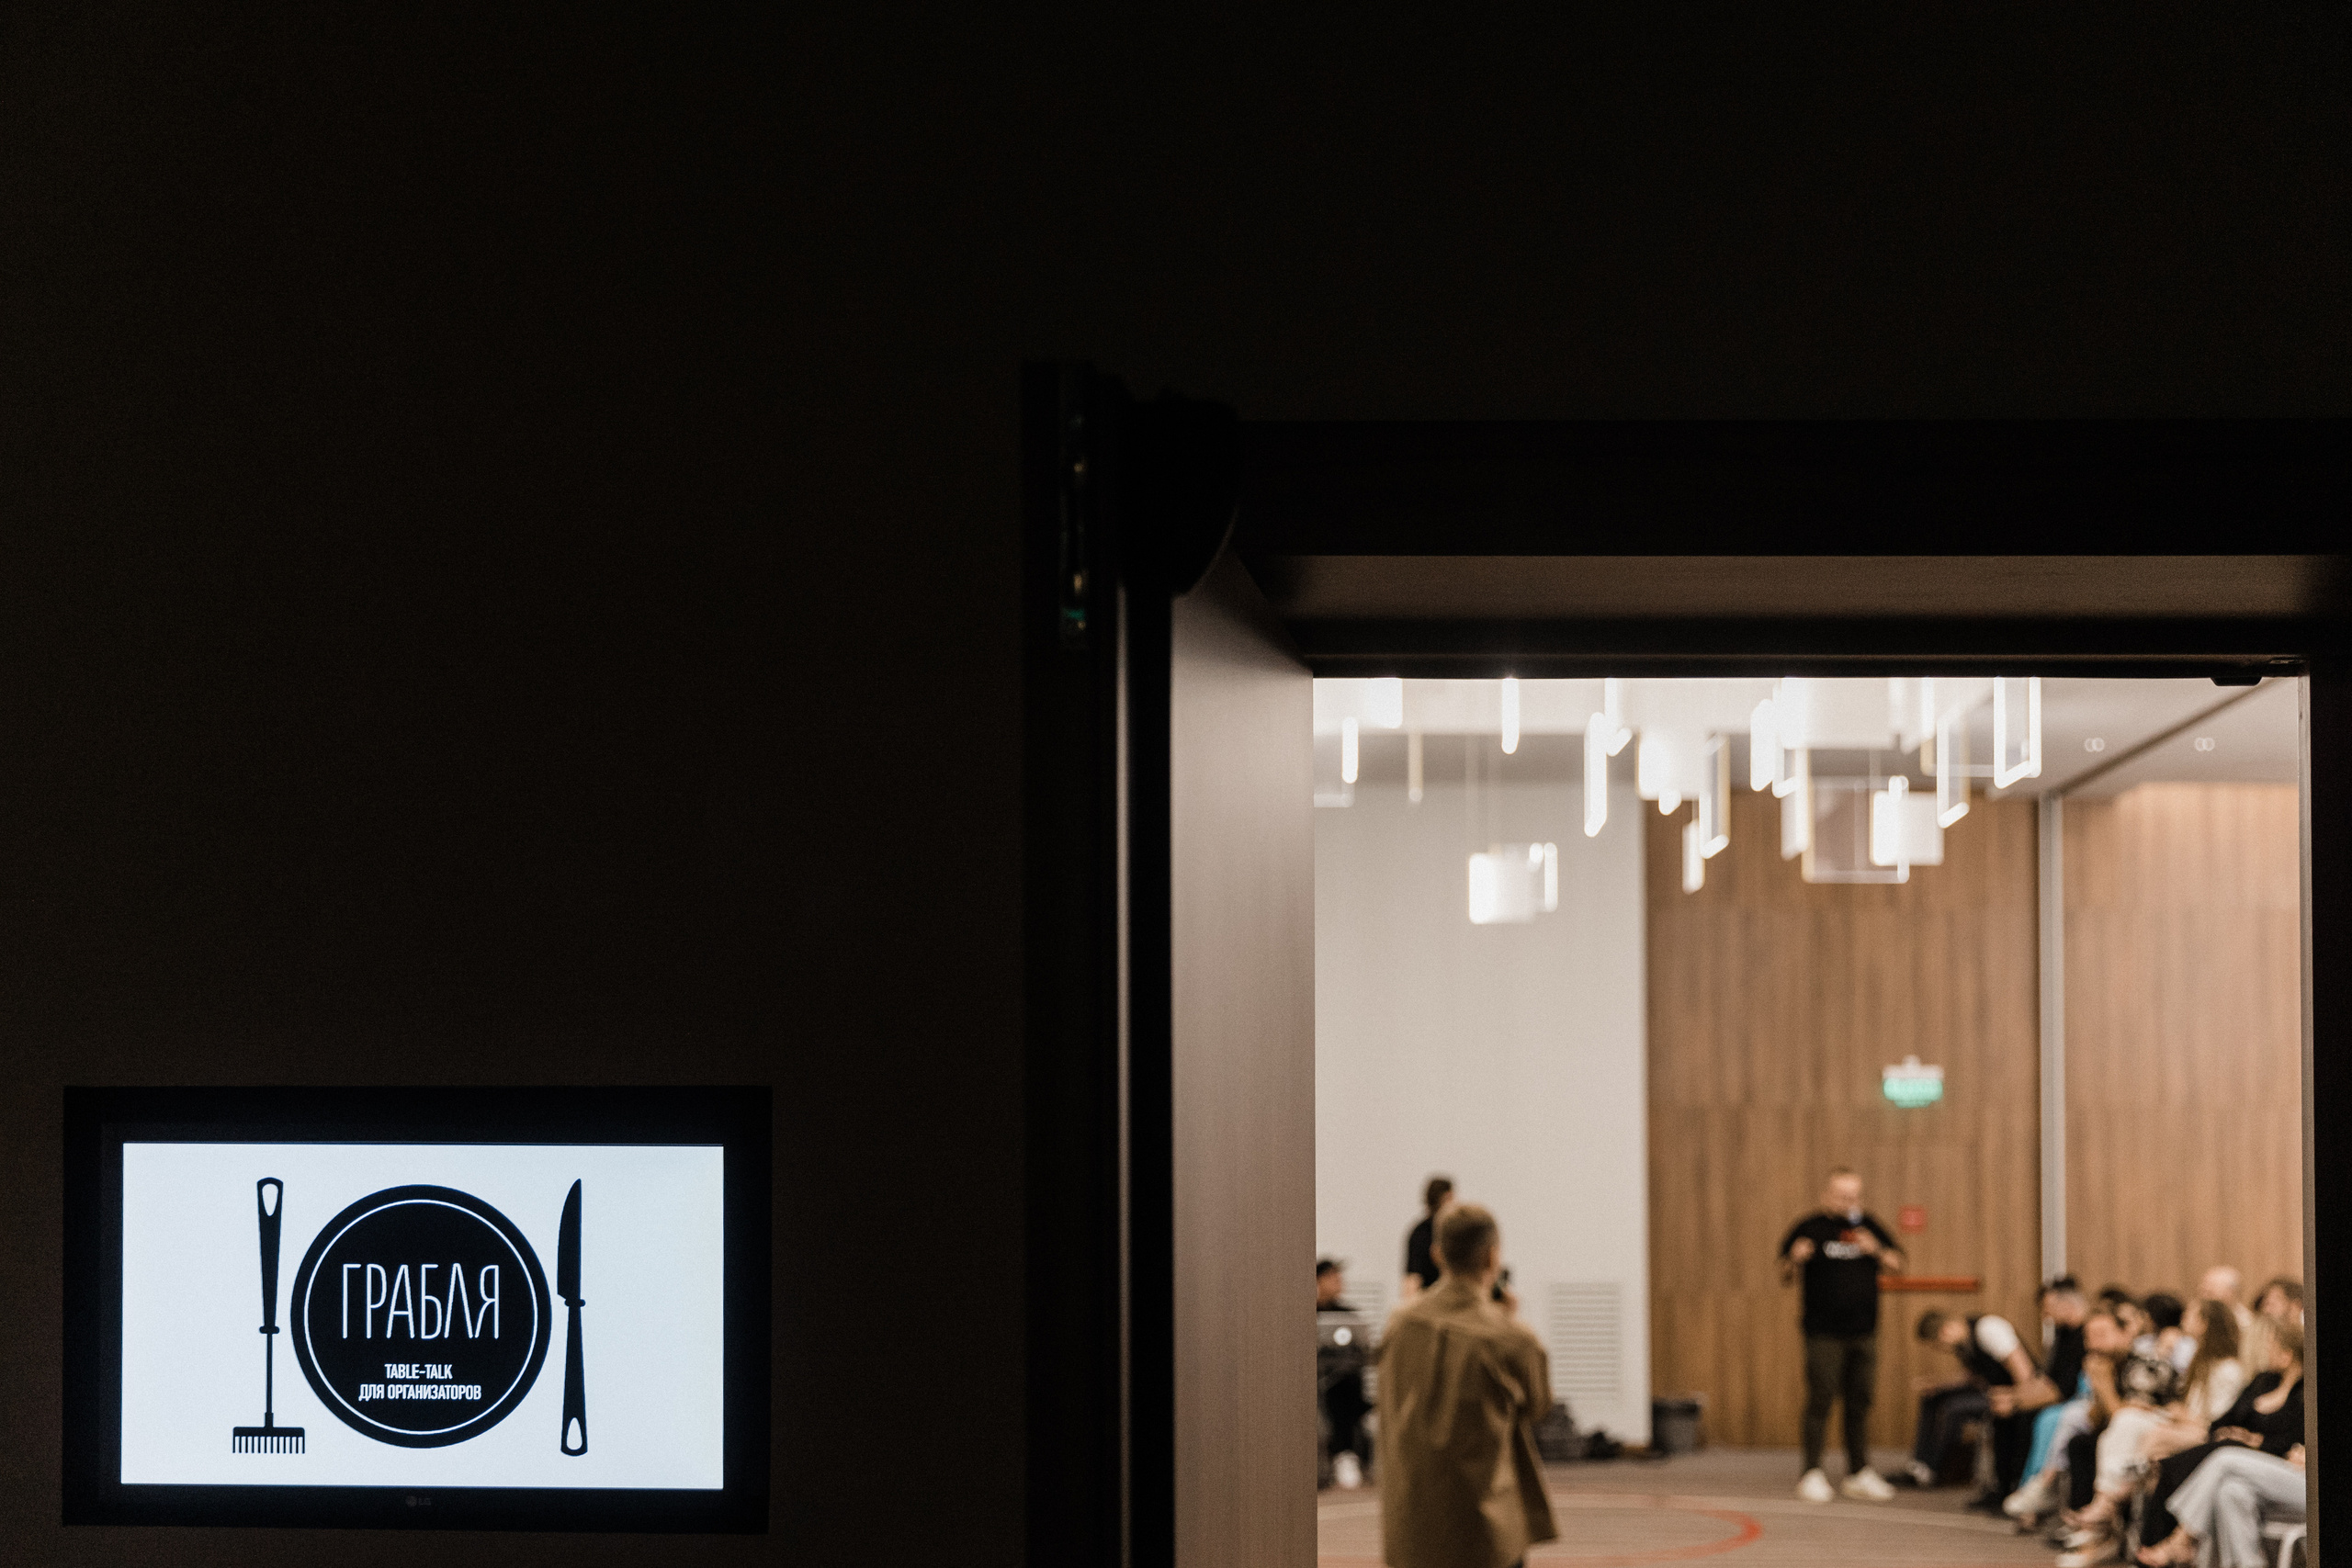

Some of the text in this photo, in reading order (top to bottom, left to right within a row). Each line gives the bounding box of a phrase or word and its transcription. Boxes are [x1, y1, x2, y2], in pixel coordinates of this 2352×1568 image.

[342, 1263, 500, 1339] ГРАБЛЯ
[384, 1363, 453, 1380] TABLE-TALK
[358, 1383, 482, 1402] ДЛЯ ОРГАНИЗАТОРОВ
